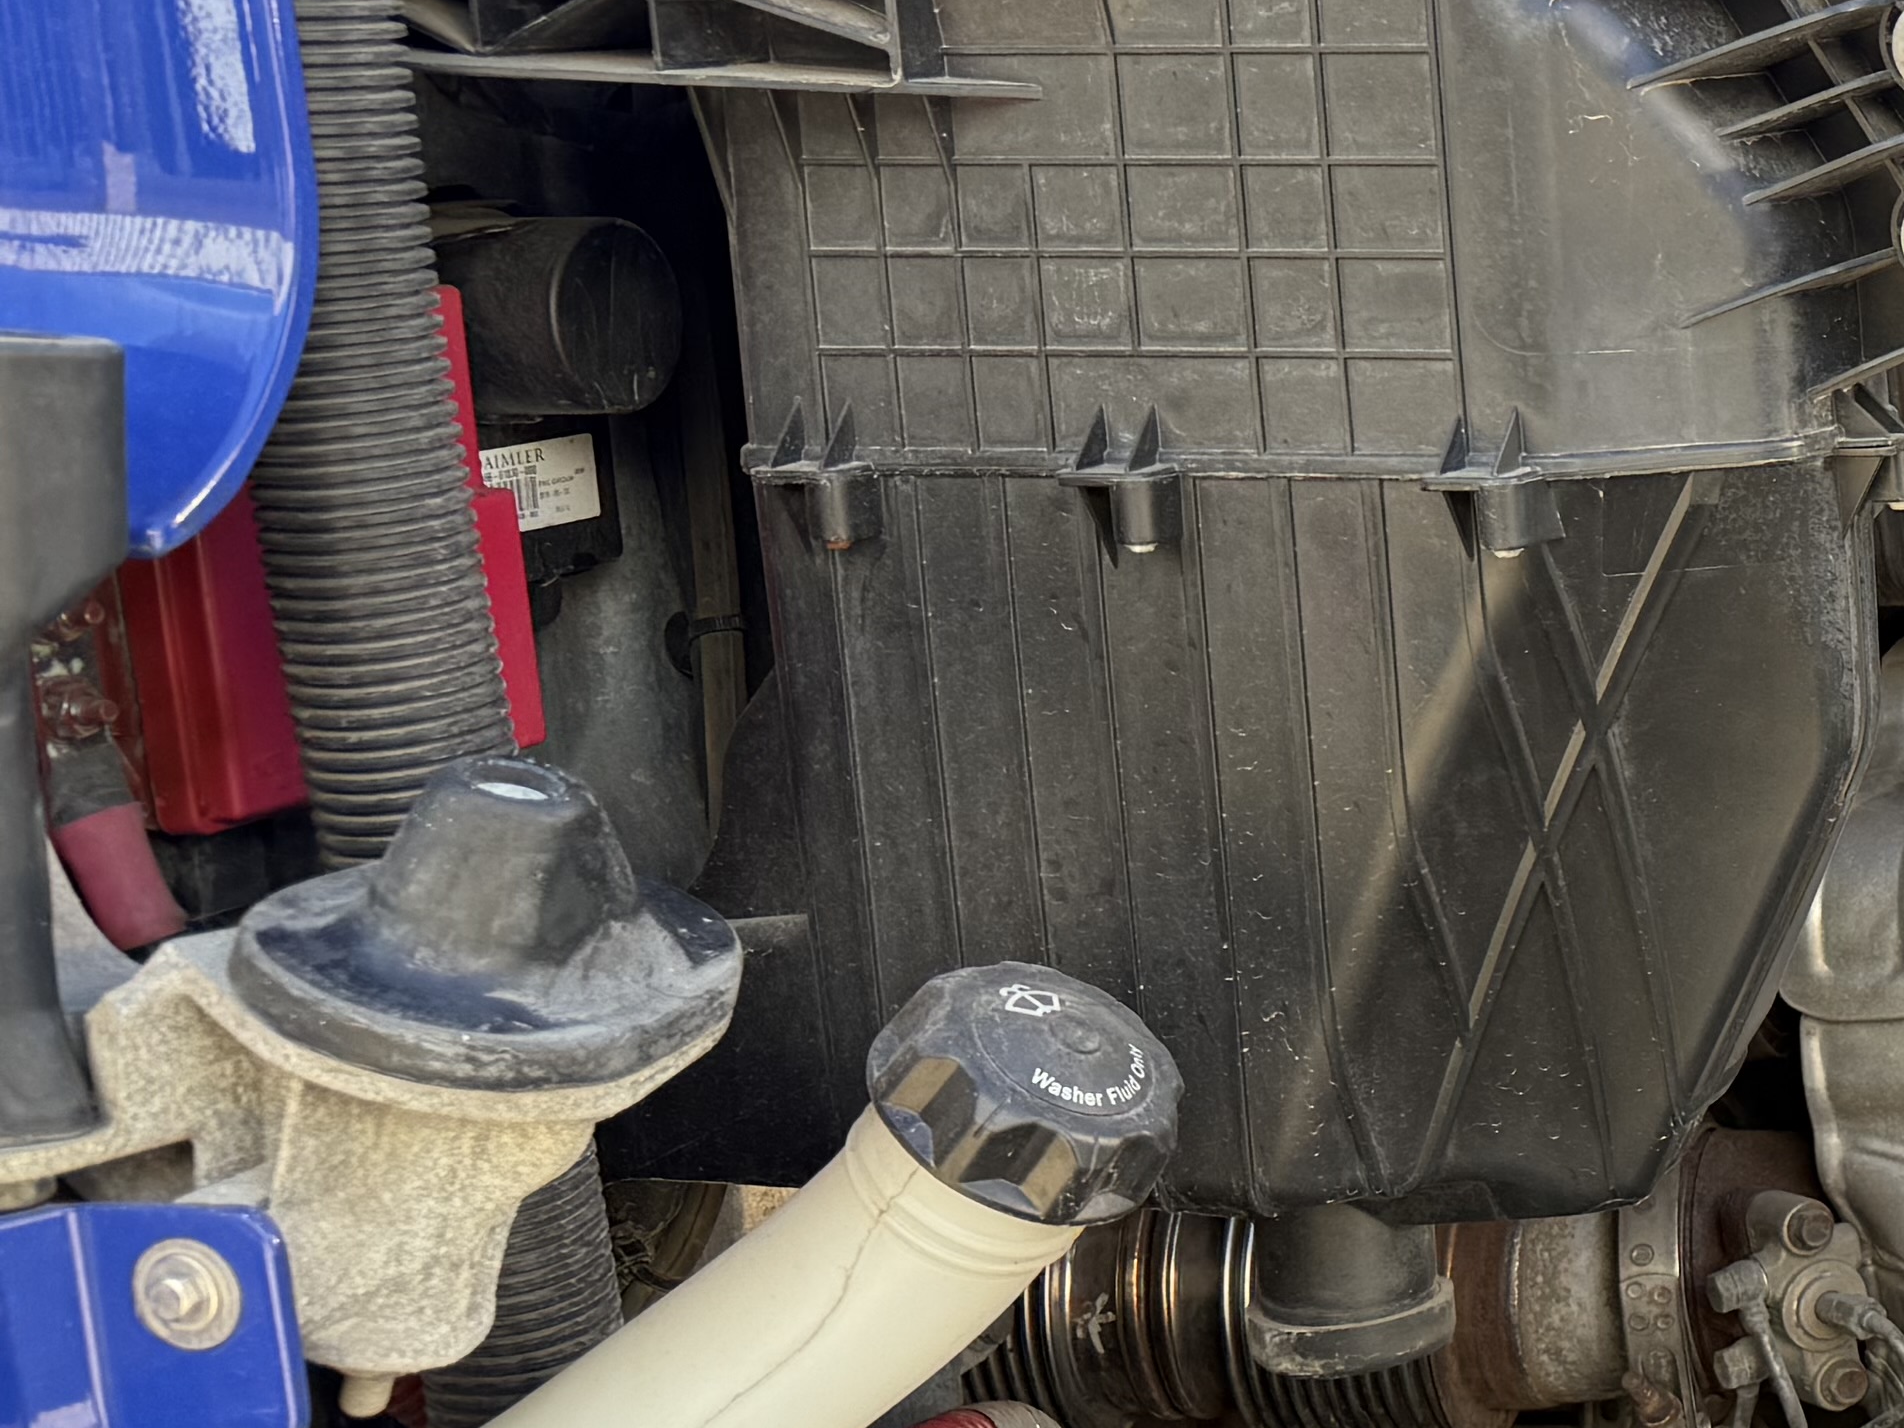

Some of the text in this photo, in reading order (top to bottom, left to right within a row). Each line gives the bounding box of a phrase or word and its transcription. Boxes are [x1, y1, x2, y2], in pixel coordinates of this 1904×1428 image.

[485, 448, 545, 469] AIMLER
[1031, 1043, 1146, 1107] Washer Fluid Only
